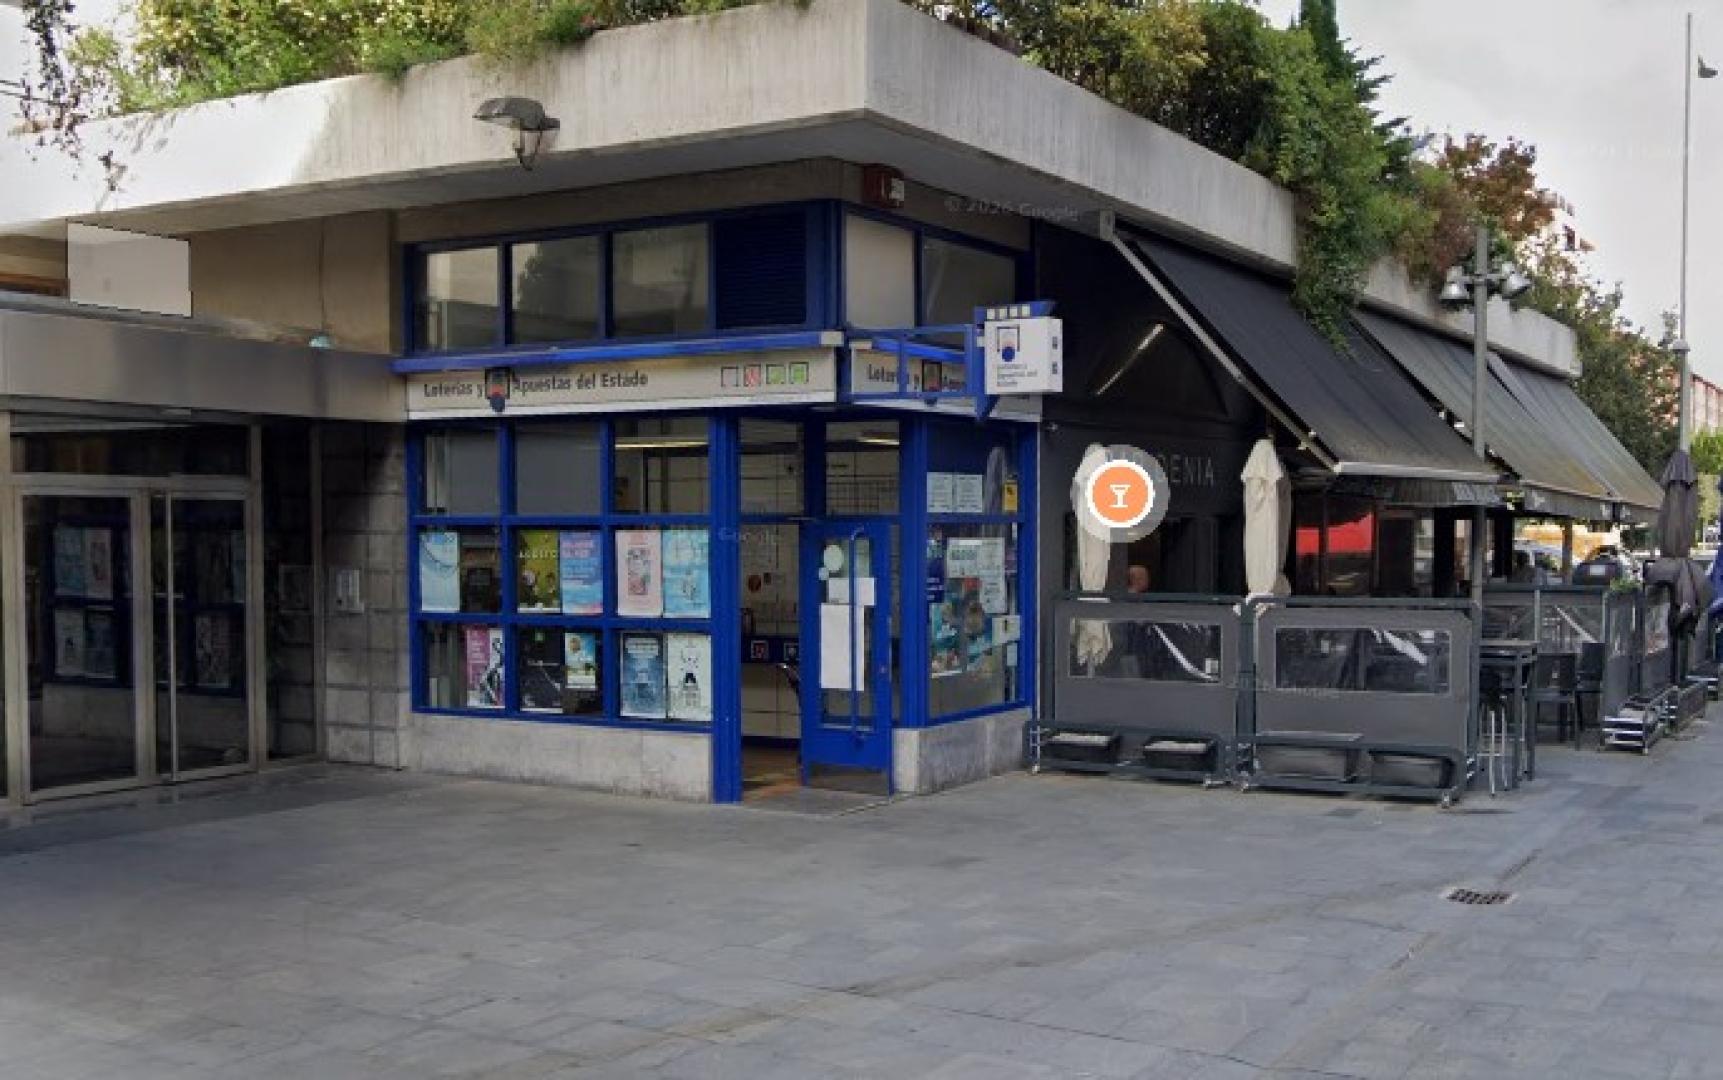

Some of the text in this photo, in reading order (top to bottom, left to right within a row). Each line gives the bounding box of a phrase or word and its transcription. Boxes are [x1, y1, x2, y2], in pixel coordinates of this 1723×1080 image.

[511, 369, 571, 396] Apuestas
[576, 373, 596, 389] del
[601, 370, 649, 388] Estado
